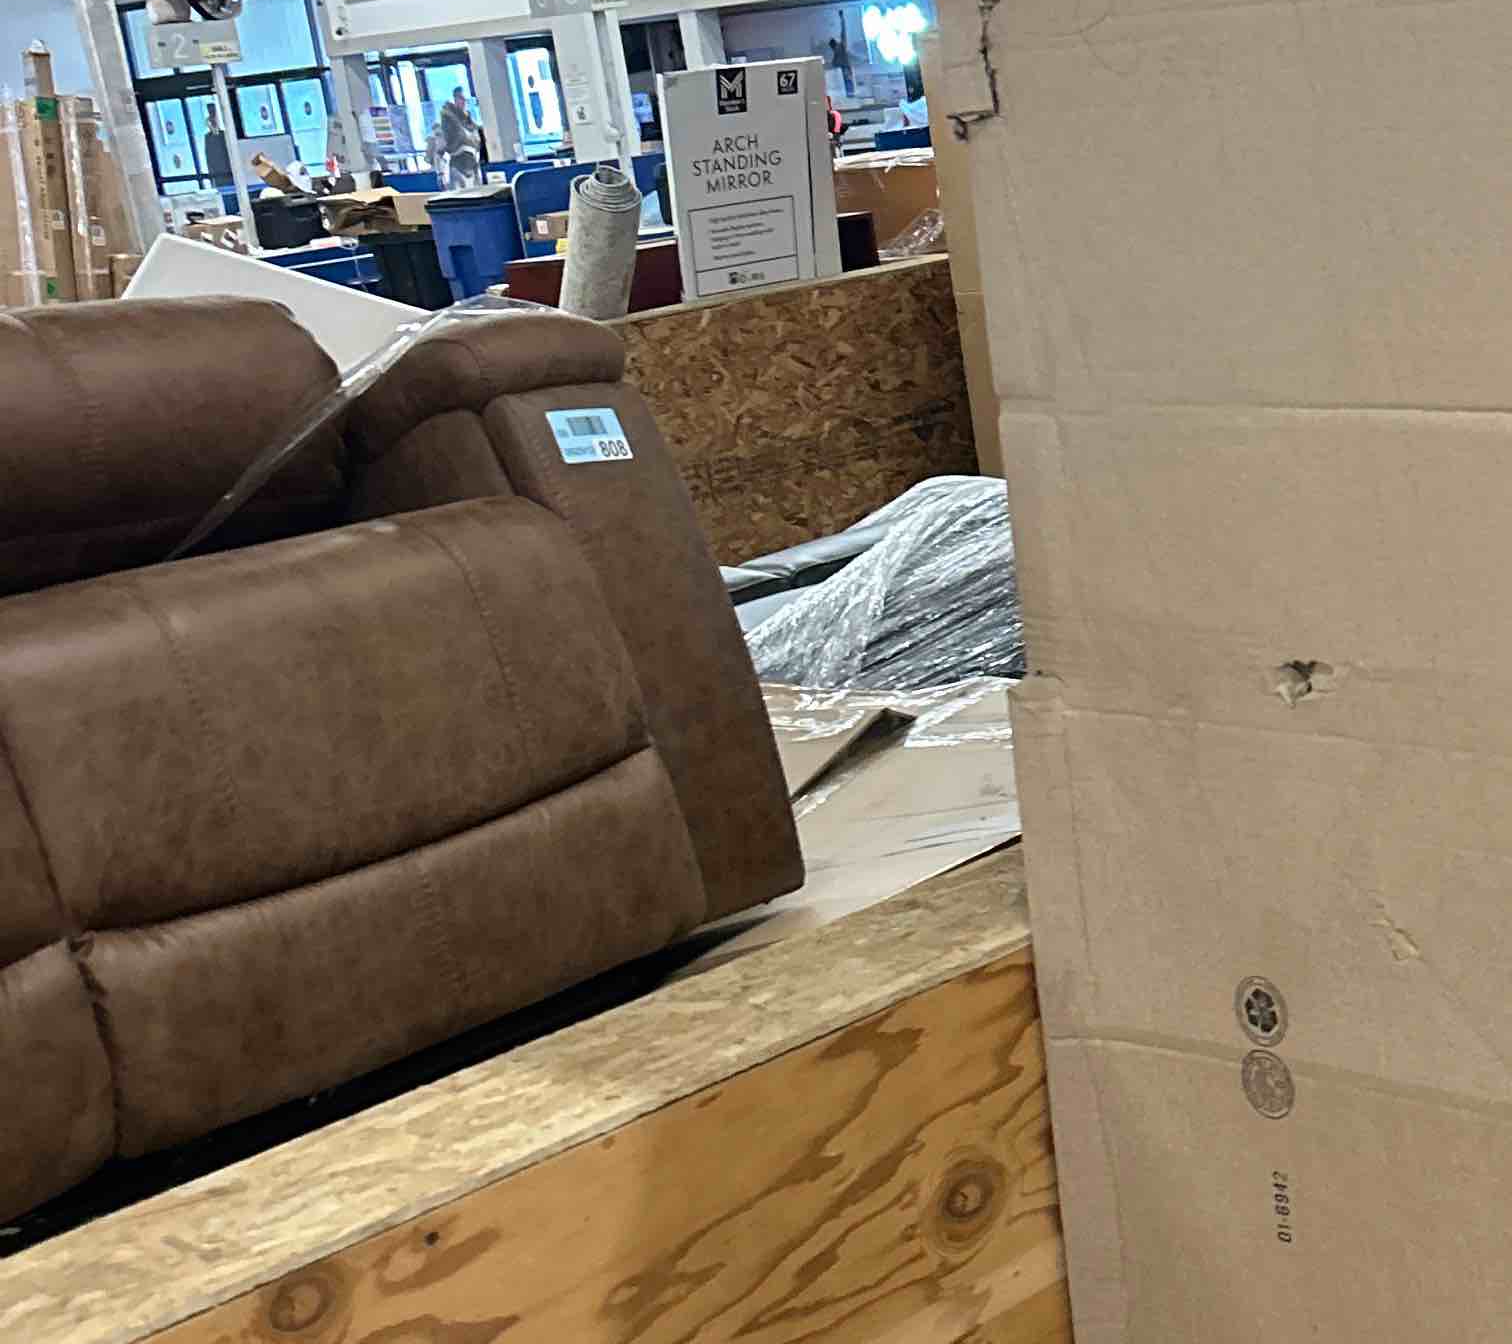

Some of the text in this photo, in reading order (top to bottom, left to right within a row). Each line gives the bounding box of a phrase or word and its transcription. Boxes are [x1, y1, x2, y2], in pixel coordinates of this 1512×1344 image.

[779, 72, 797, 88] 67
[712, 134, 759, 155] ARCH
[691, 150, 782, 177] STANDING
[706, 169, 774, 194] MIRROR
